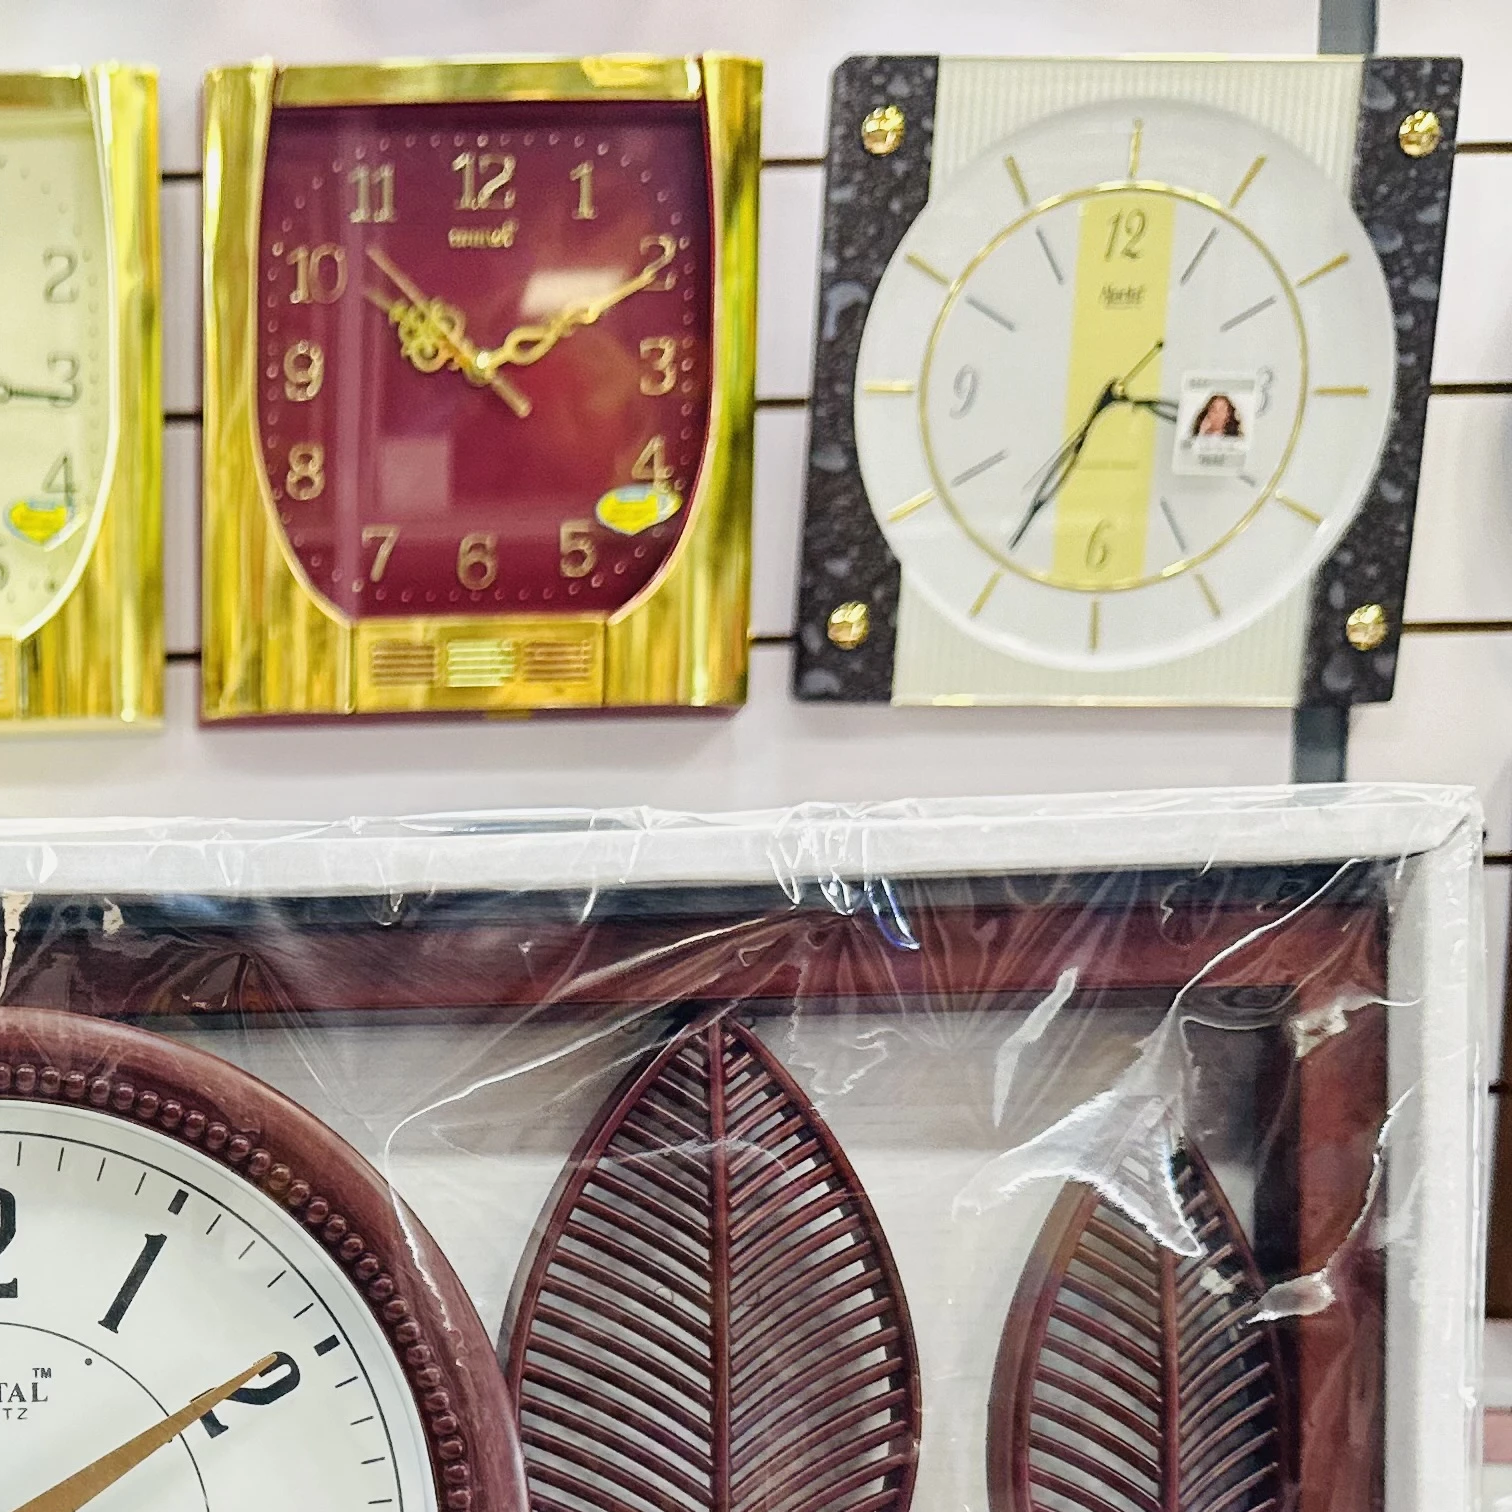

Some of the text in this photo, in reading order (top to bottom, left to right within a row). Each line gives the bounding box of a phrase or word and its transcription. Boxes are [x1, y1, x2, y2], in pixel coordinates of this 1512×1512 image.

[347, 162, 397, 223] 11
[452, 152, 517, 211] 12
[570, 160, 598, 219] 1
[639, 233, 677, 291] 2
[1104, 208, 1147, 262] 12
[42, 247, 78, 303] 2
[288, 244, 348, 305] 10
[46, 352, 81, 408] 3
[284, 340, 326, 402] 9
[639, 336, 677, 396] 3
[950, 365, 980, 418] 9
[42, 453, 78, 521] 4
[286, 443, 326, 502] 8
[631, 434, 674, 497] 4
[361, 523, 399, 584] 7
[456, 532, 498, 592] 6
[558, 520, 598, 579] 5
[1085, 520, 1111, 569] 6
[98, 1233, 168, 1334] 1
[189, 1351, 301, 1439] 2
